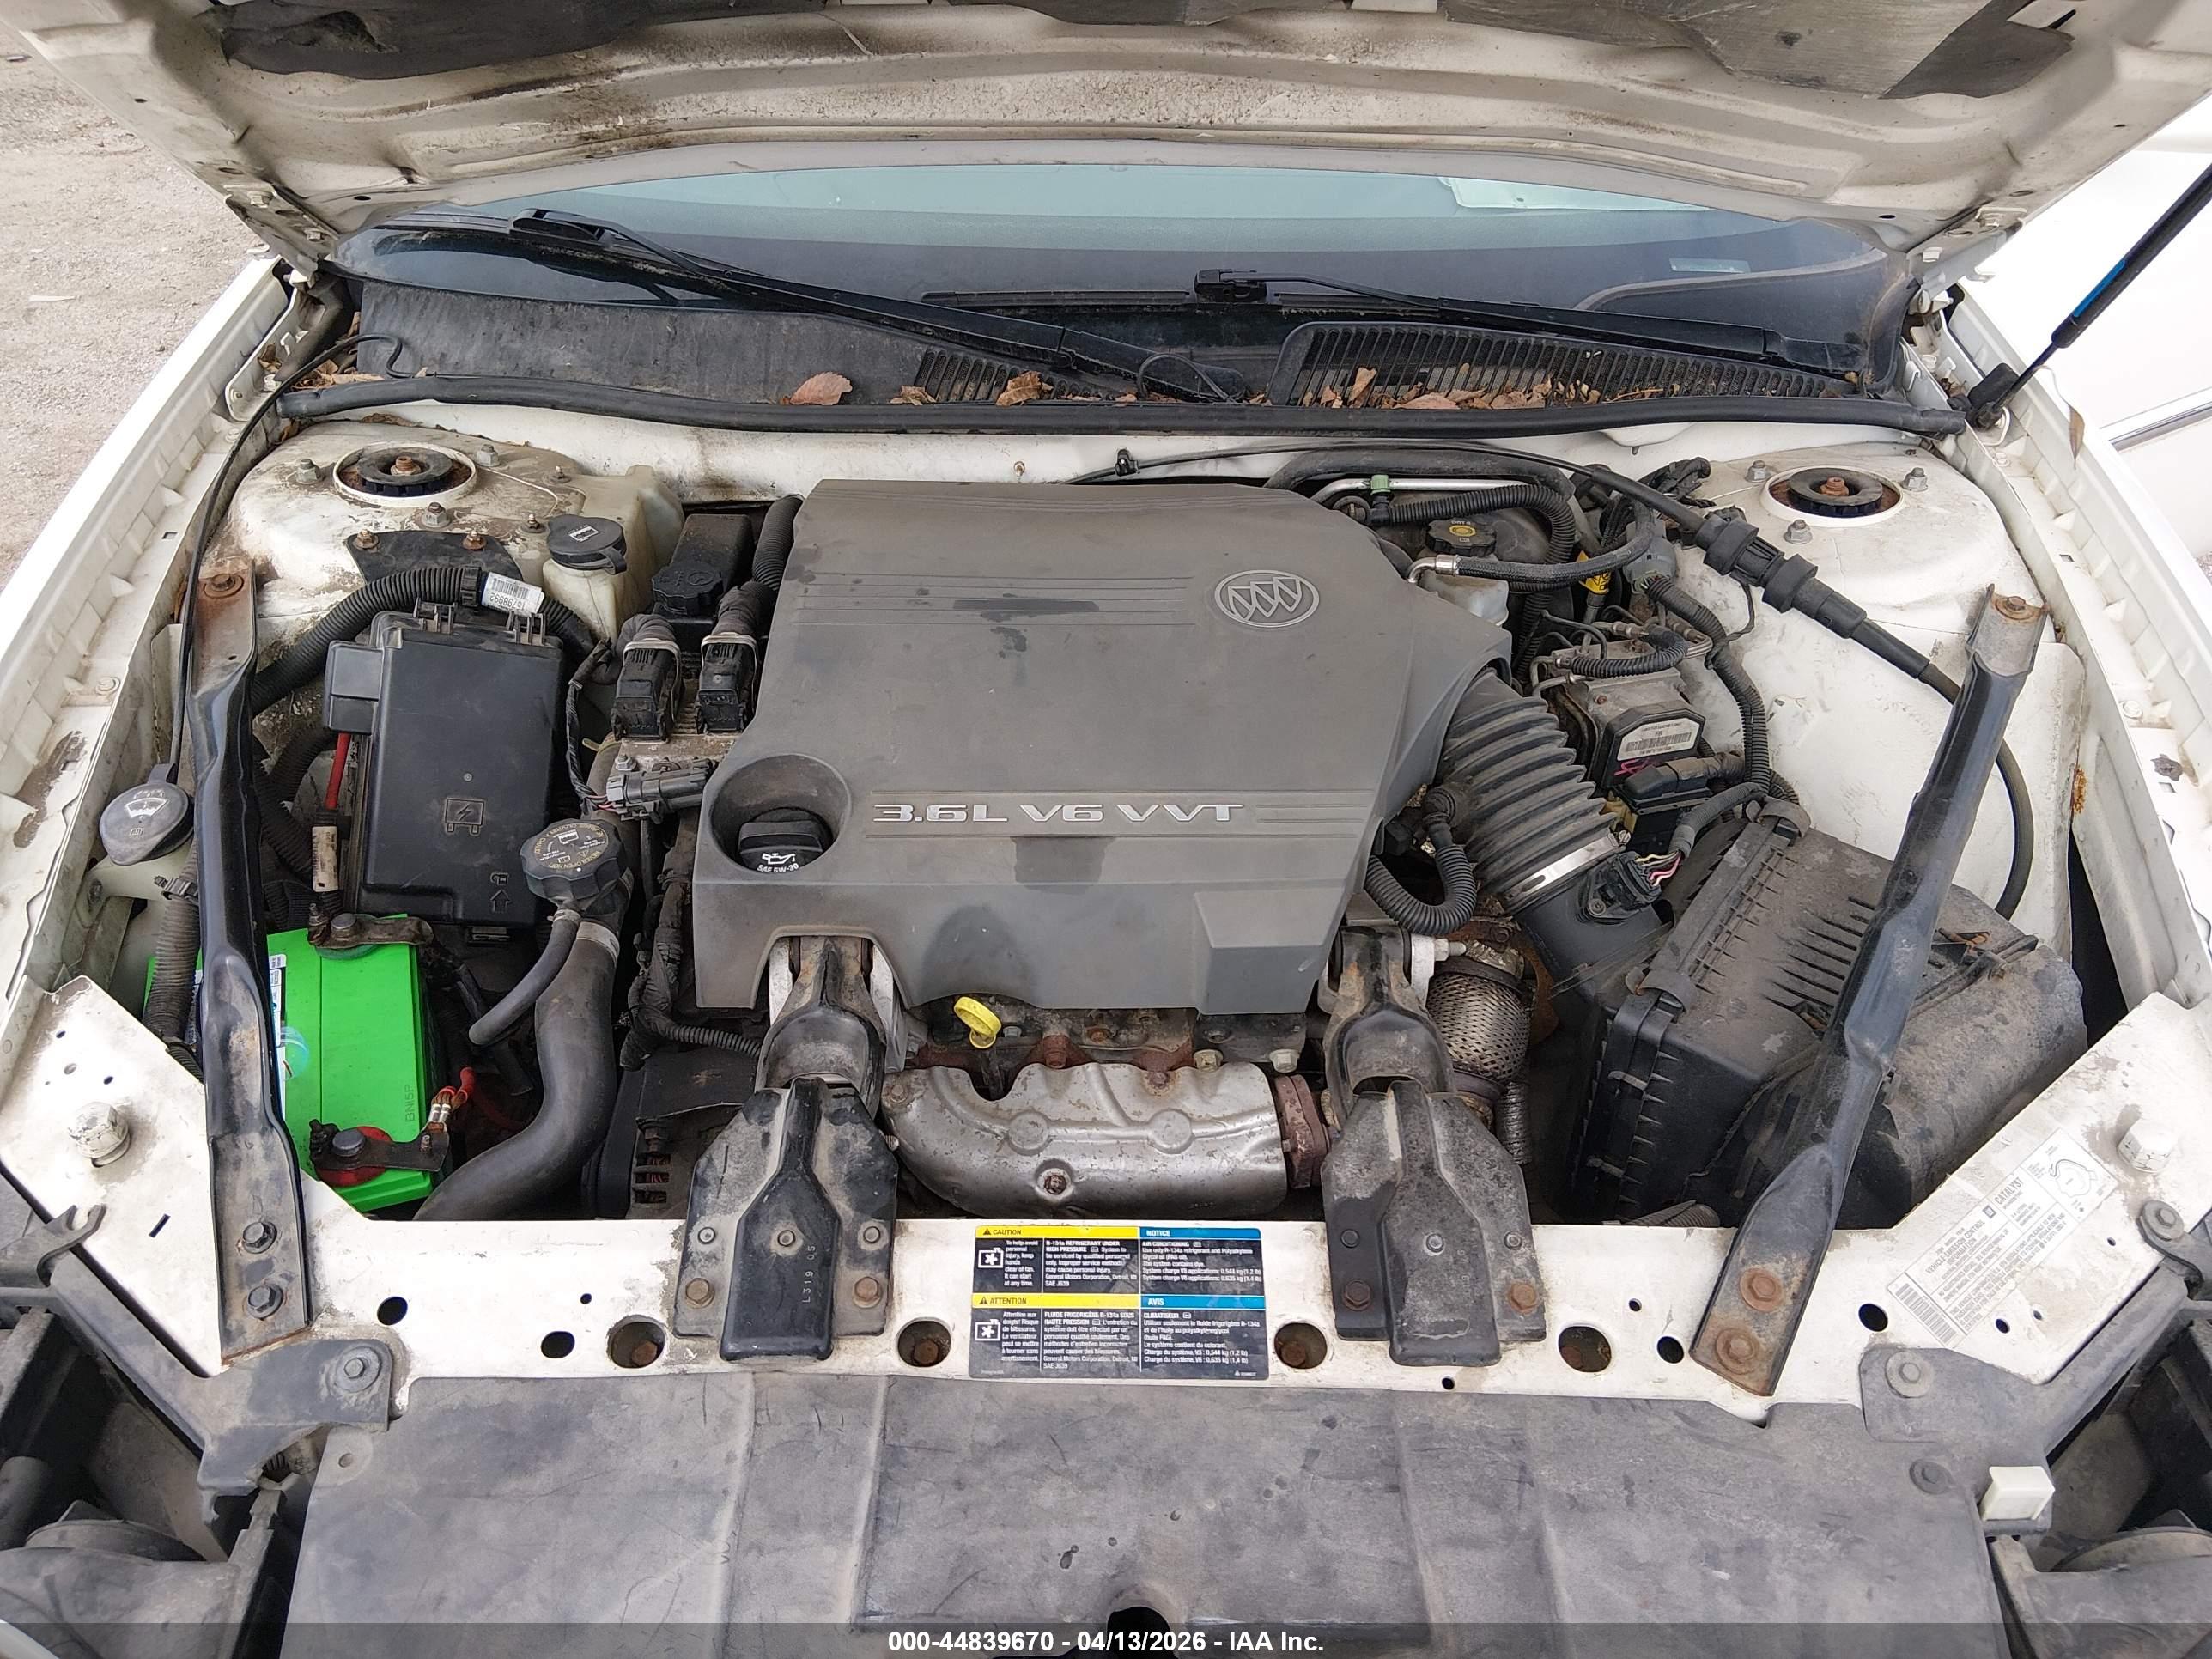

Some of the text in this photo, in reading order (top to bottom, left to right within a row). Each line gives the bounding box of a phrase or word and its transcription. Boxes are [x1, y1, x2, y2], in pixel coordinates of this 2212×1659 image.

[489, 592, 526, 611] 15798992
[873, 805, 1243, 822] 3.6L V6 VVT
[757, 864, 773, 872] SAE
[1993, 1176, 2024, 1206] CATALYST
